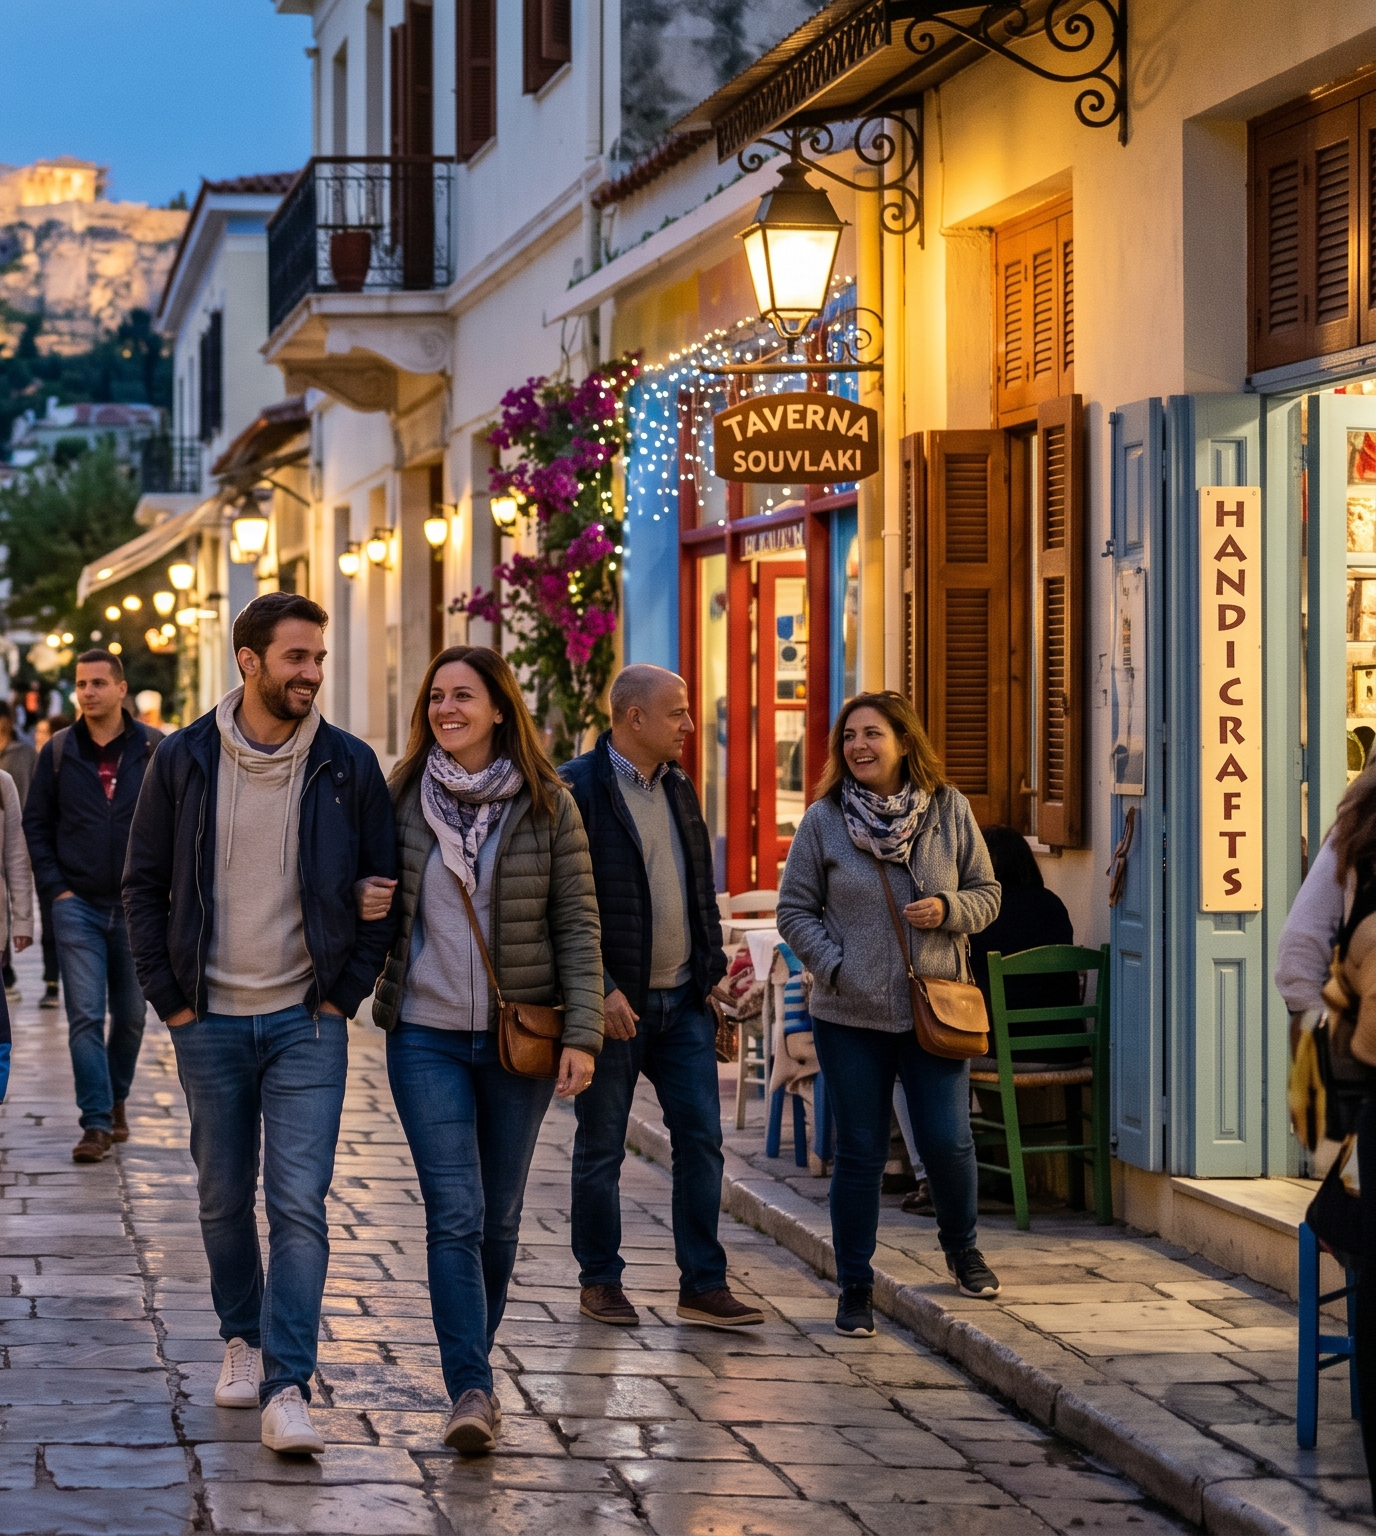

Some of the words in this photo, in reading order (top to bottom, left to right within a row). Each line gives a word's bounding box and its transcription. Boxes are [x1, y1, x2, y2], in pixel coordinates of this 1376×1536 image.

[723, 404, 869, 443] TAVERNA
[733, 450, 862, 473] SOUVLAKI
[1213, 500, 1248, 896] HANDICRAFTS
